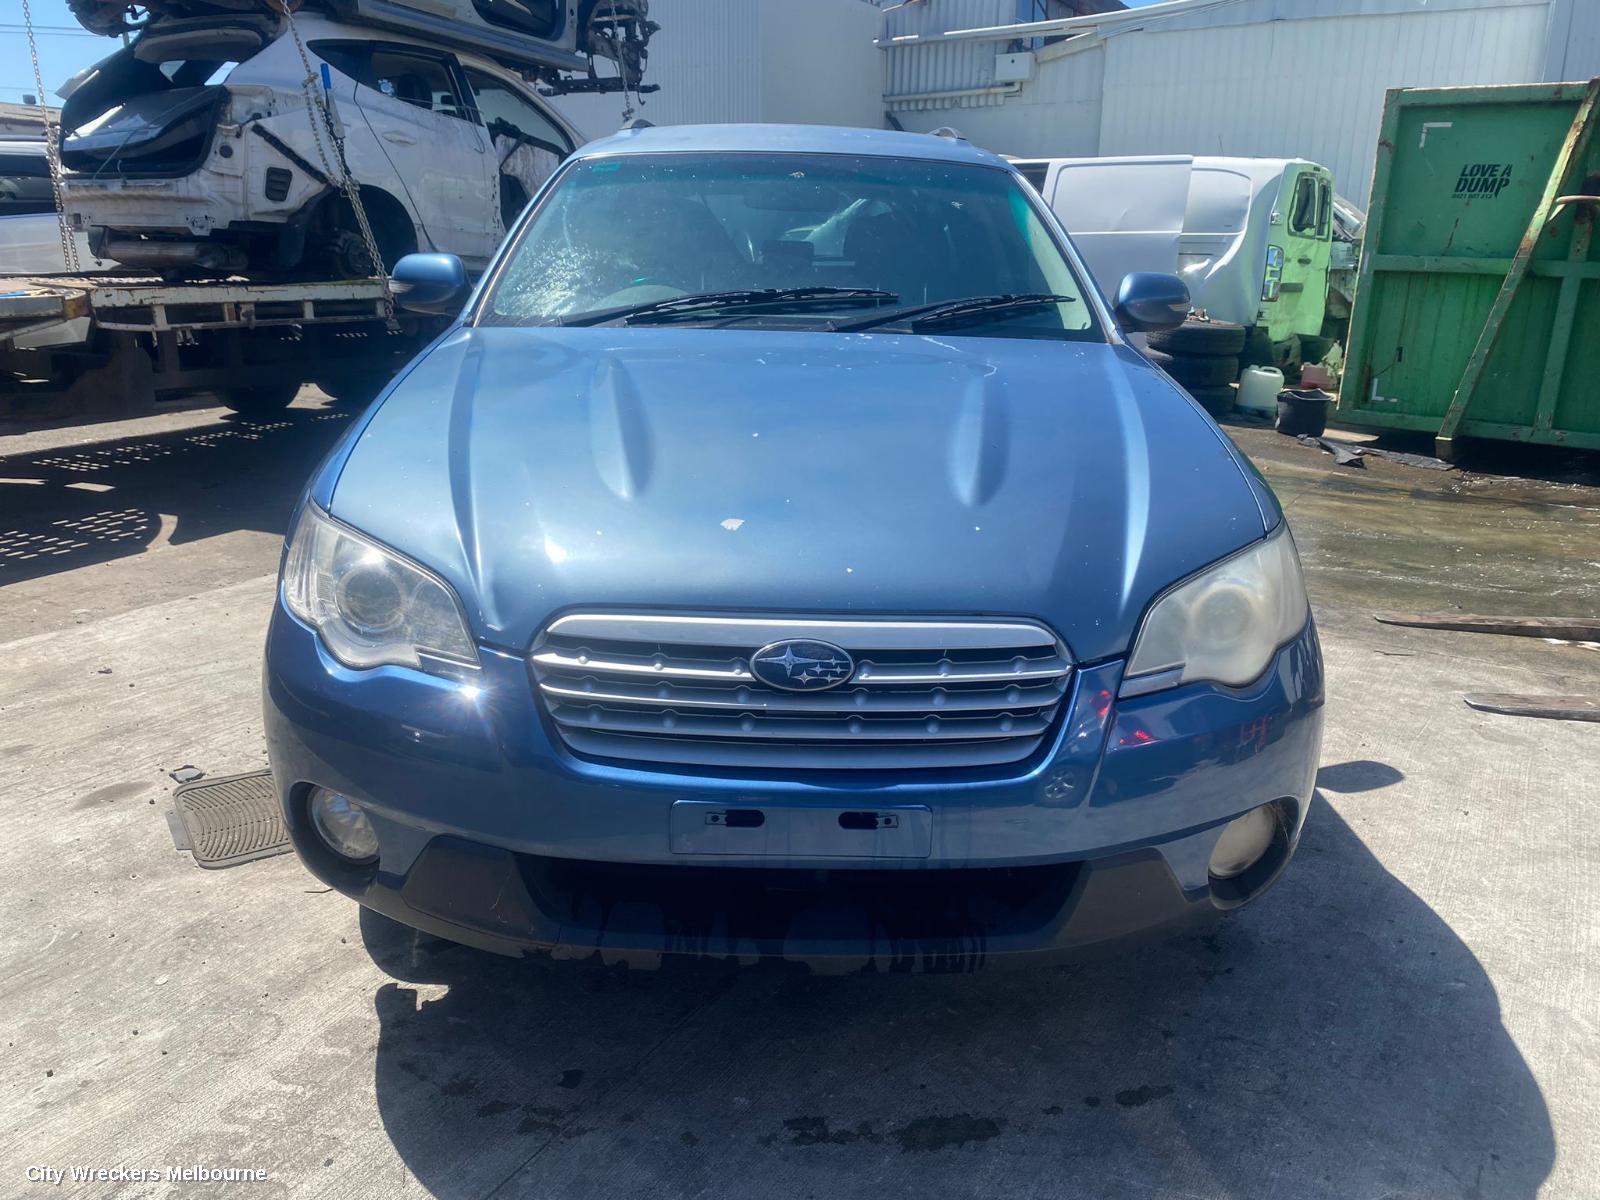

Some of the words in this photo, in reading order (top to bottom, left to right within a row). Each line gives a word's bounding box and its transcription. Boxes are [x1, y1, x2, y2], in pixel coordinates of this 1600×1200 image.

[1460, 164, 1500, 177] LOVE
[1500, 164, 1513, 177] A
[1454, 177, 1510, 198] DUMP
